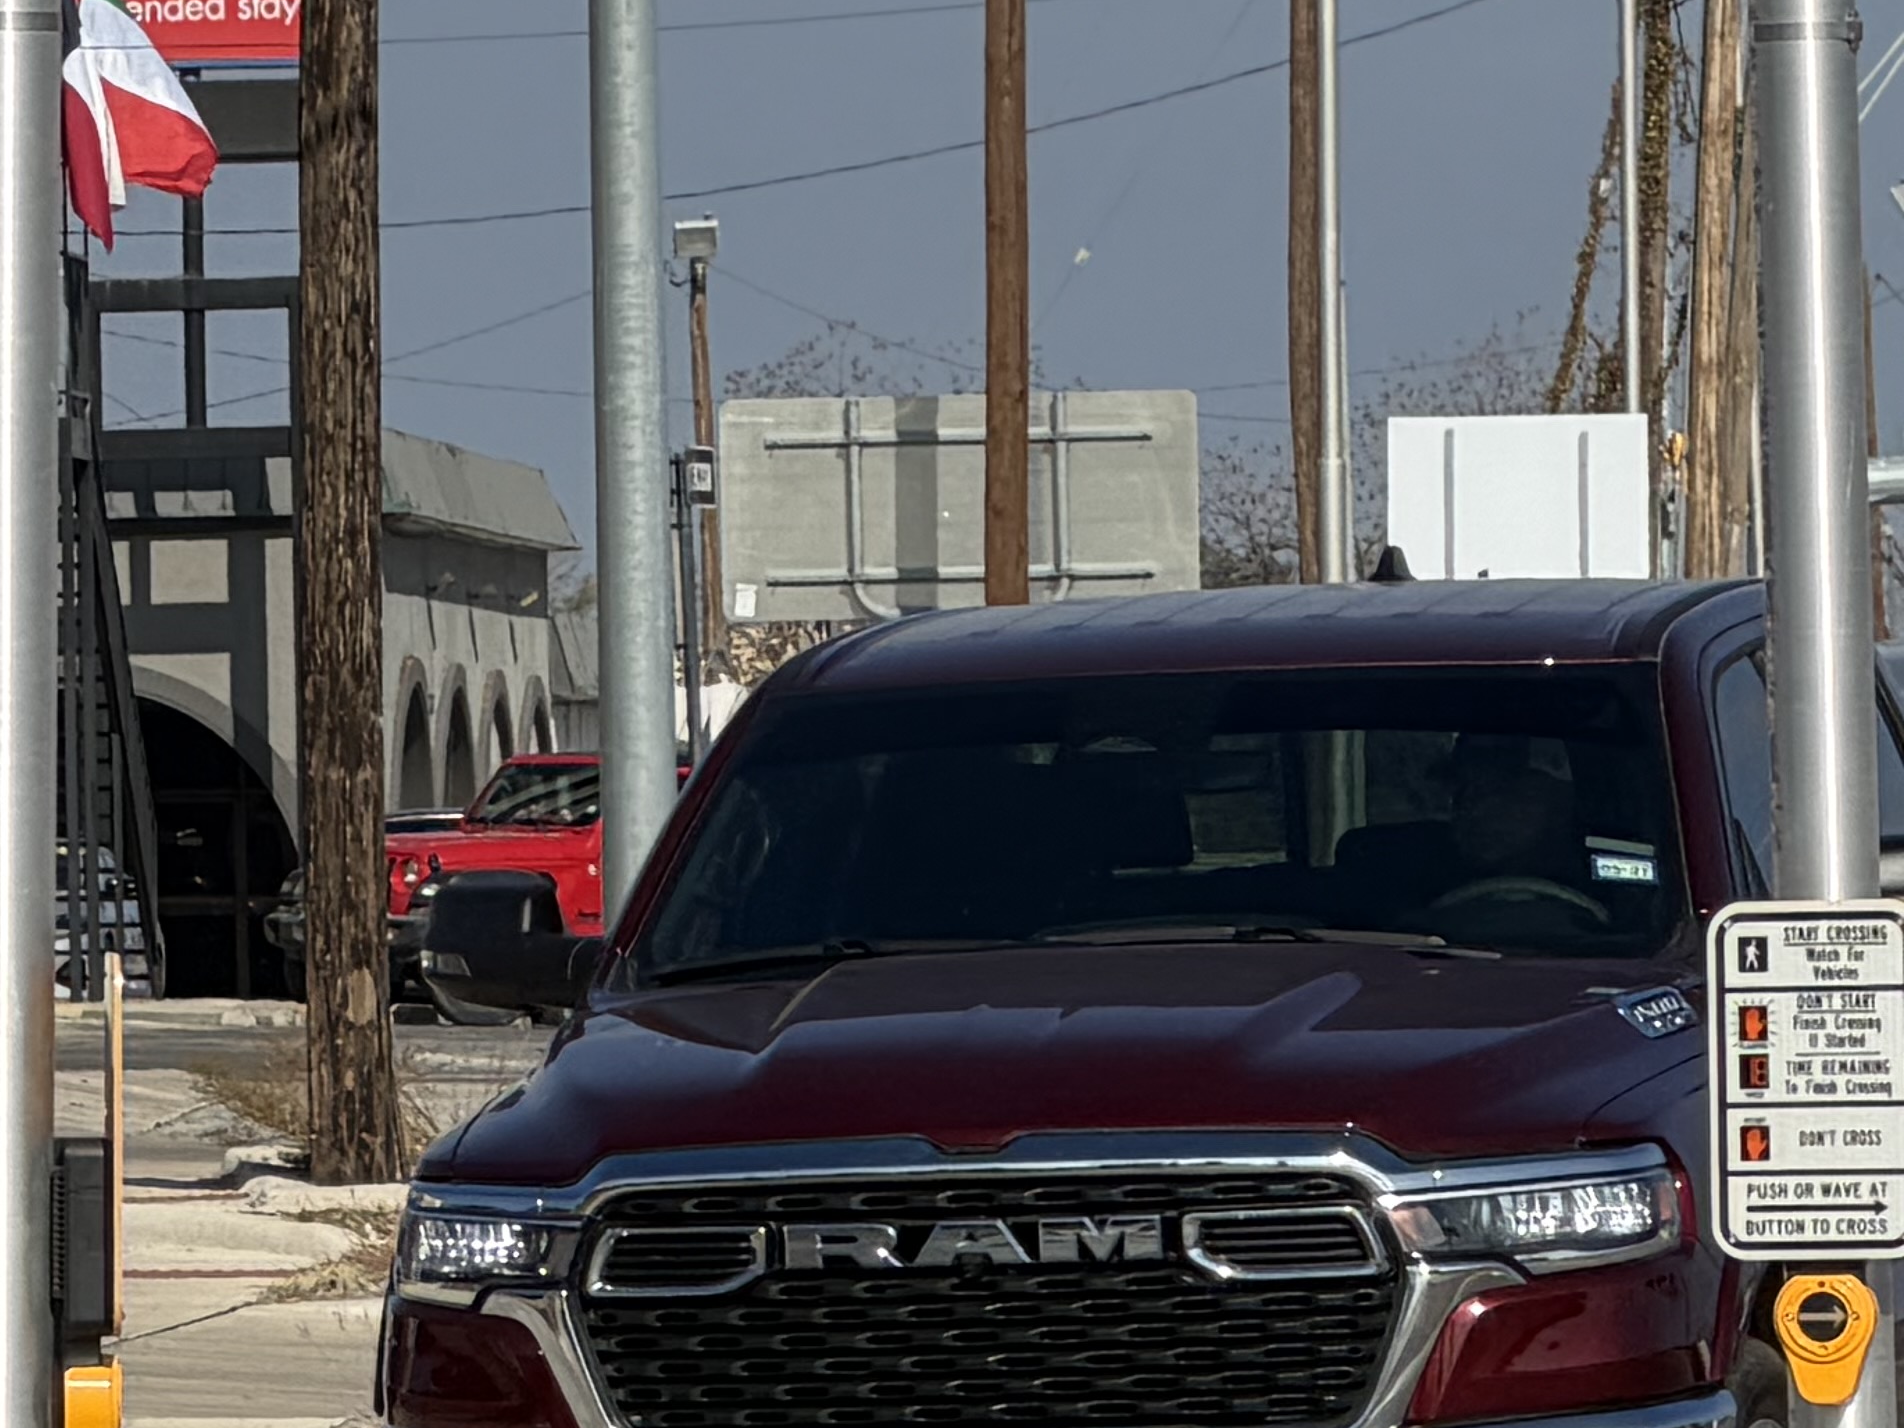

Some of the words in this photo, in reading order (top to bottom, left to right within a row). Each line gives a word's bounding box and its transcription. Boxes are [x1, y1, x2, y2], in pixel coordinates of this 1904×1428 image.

[1783, 925, 1820, 941] START
[1826, 924, 1888, 941] CROSSING
[1813, 964, 1859, 981] Vehicles
[1796, 993, 1833, 1009] DON'T
[1840, 993, 1876, 1009] START
[1793, 1014, 1827, 1031] Finish
[1834, 1013, 1882, 1033] Crossing
[1824, 1032, 1866, 1048] Started
[1786, 1059, 1814, 1076] TIME
[1821, 1058, 1891, 1076] REMAINING
[1845, 1078, 1892, 1098] Crossing
[1798, 1129, 1837, 1147] DON'T
[1842, 1129, 1882, 1146] CROSS
[1746, 1182, 1788, 1200] PUSH
[1793, 1182, 1815, 1199] OR
[1820, 1181, 1862, 1199] WAVE
[1868, 1181, 1889, 1198] AT
[1745, 1219, 1806, 1236] BUTTON
[1811, 1218, 1831, 1235] TO
[1835, 1218, 1889, 1235] CROSS
[782, 1214, 1164, 1269] RAM
